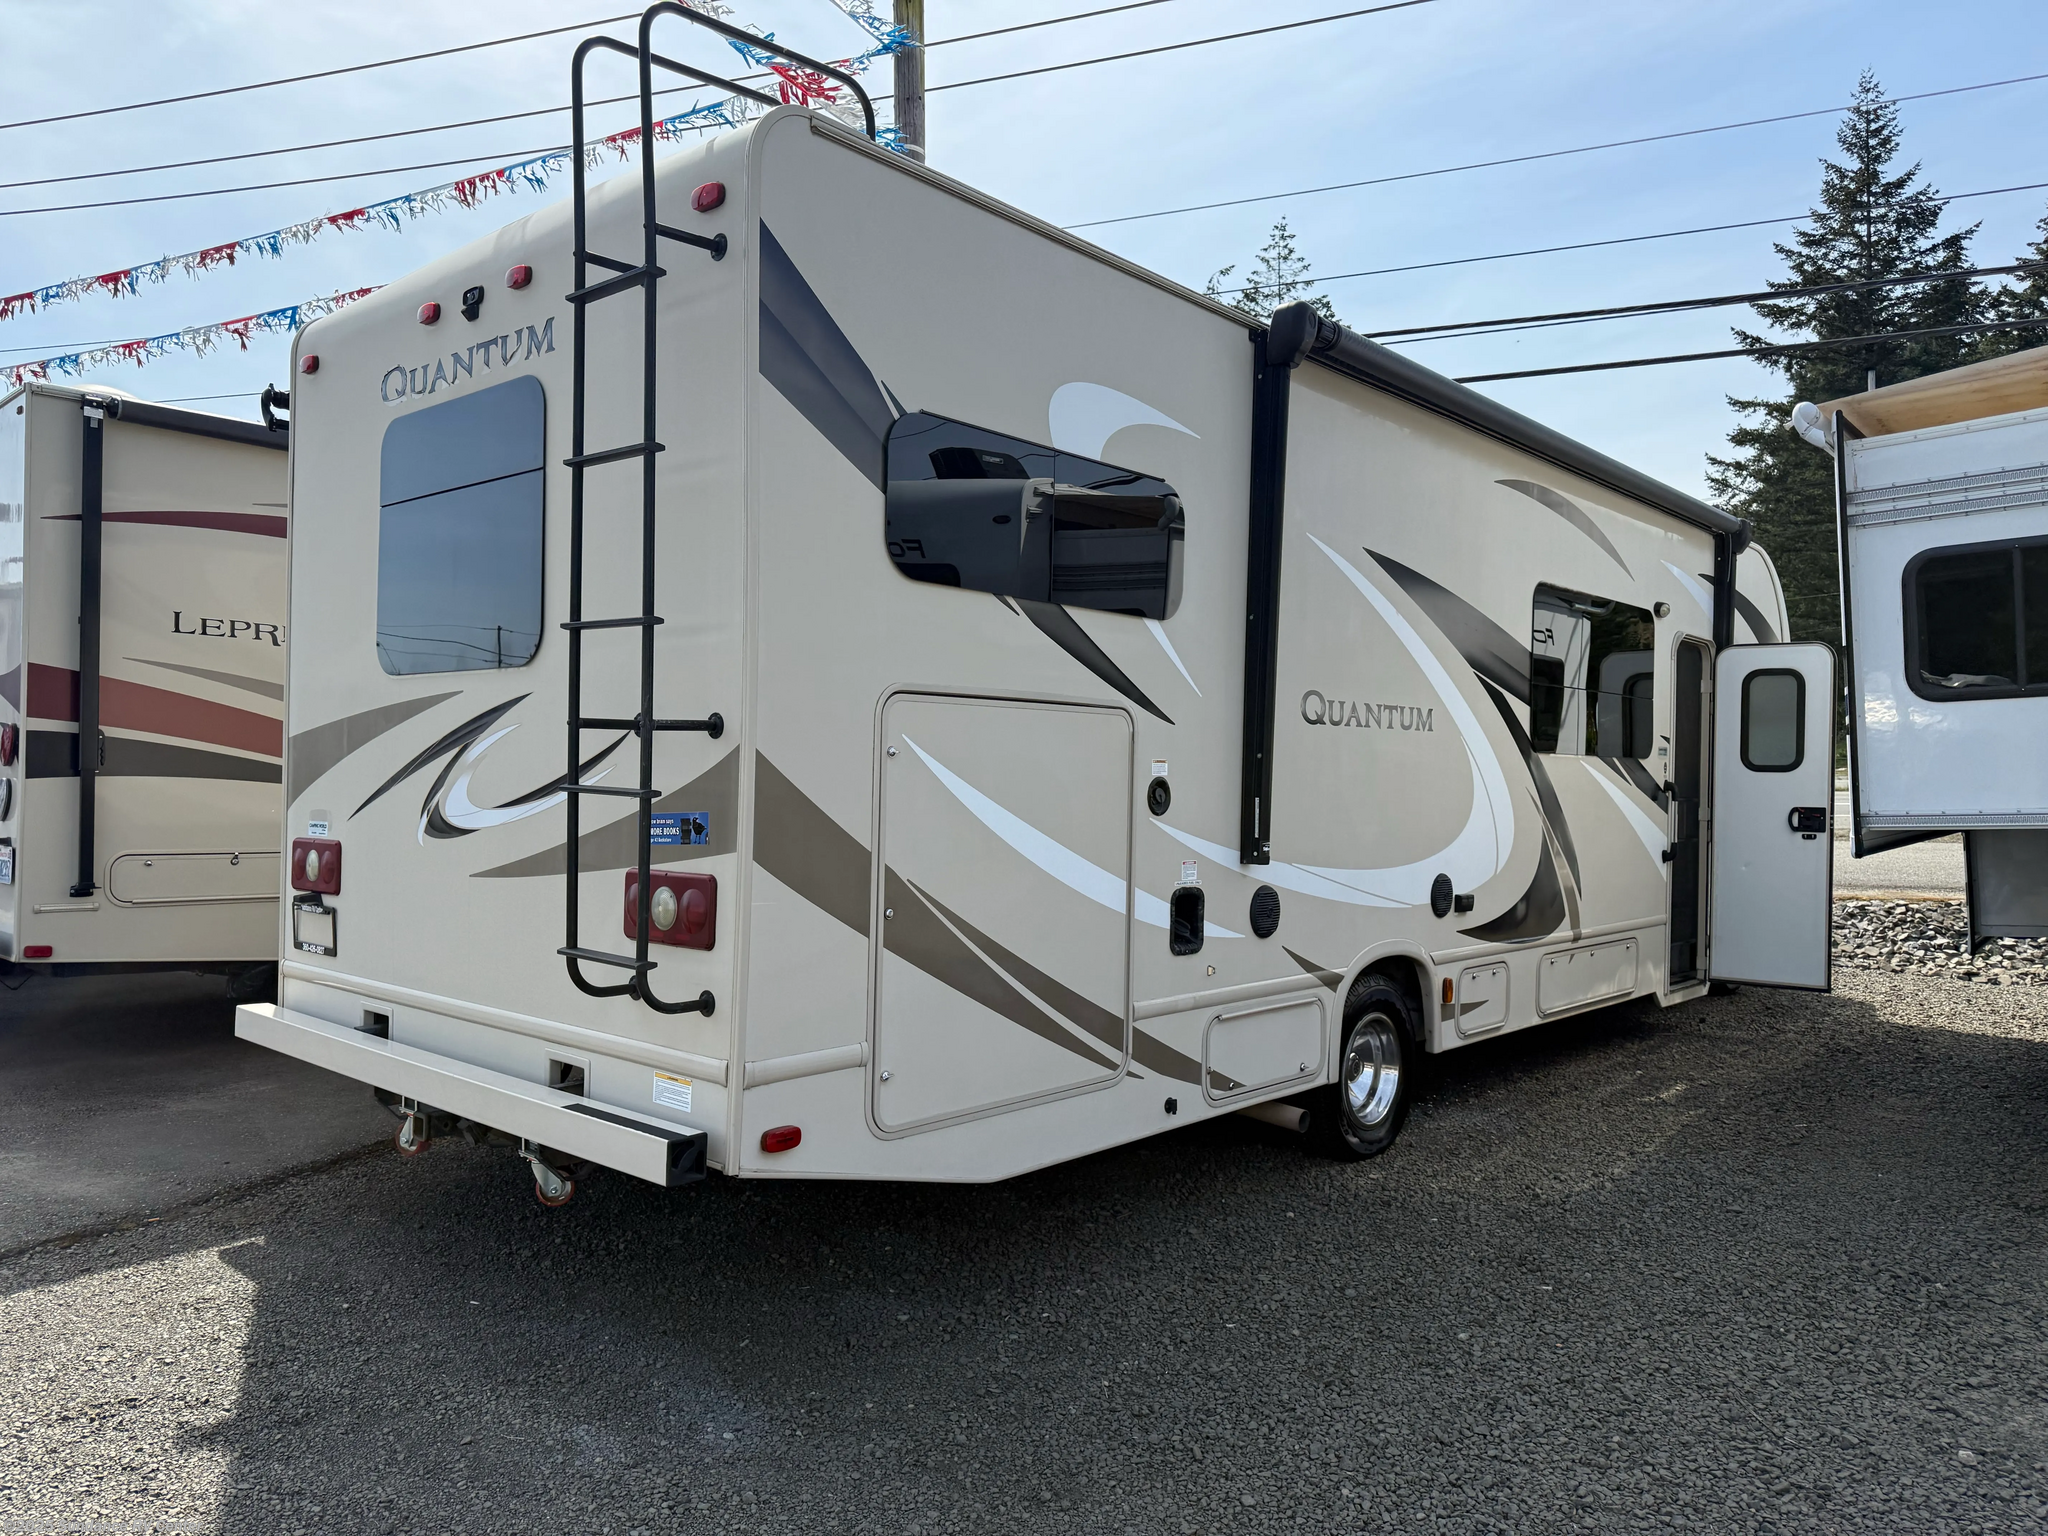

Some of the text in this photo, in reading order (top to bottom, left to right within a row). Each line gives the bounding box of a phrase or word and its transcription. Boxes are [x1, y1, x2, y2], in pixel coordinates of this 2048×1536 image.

[381, 317, 556, 404] QUANTUM
[171, 611, 286, 647] LEPR
[1300, 690, 1434, 732] QUANTUM
[663, 826, 680, 835] BOOKS
